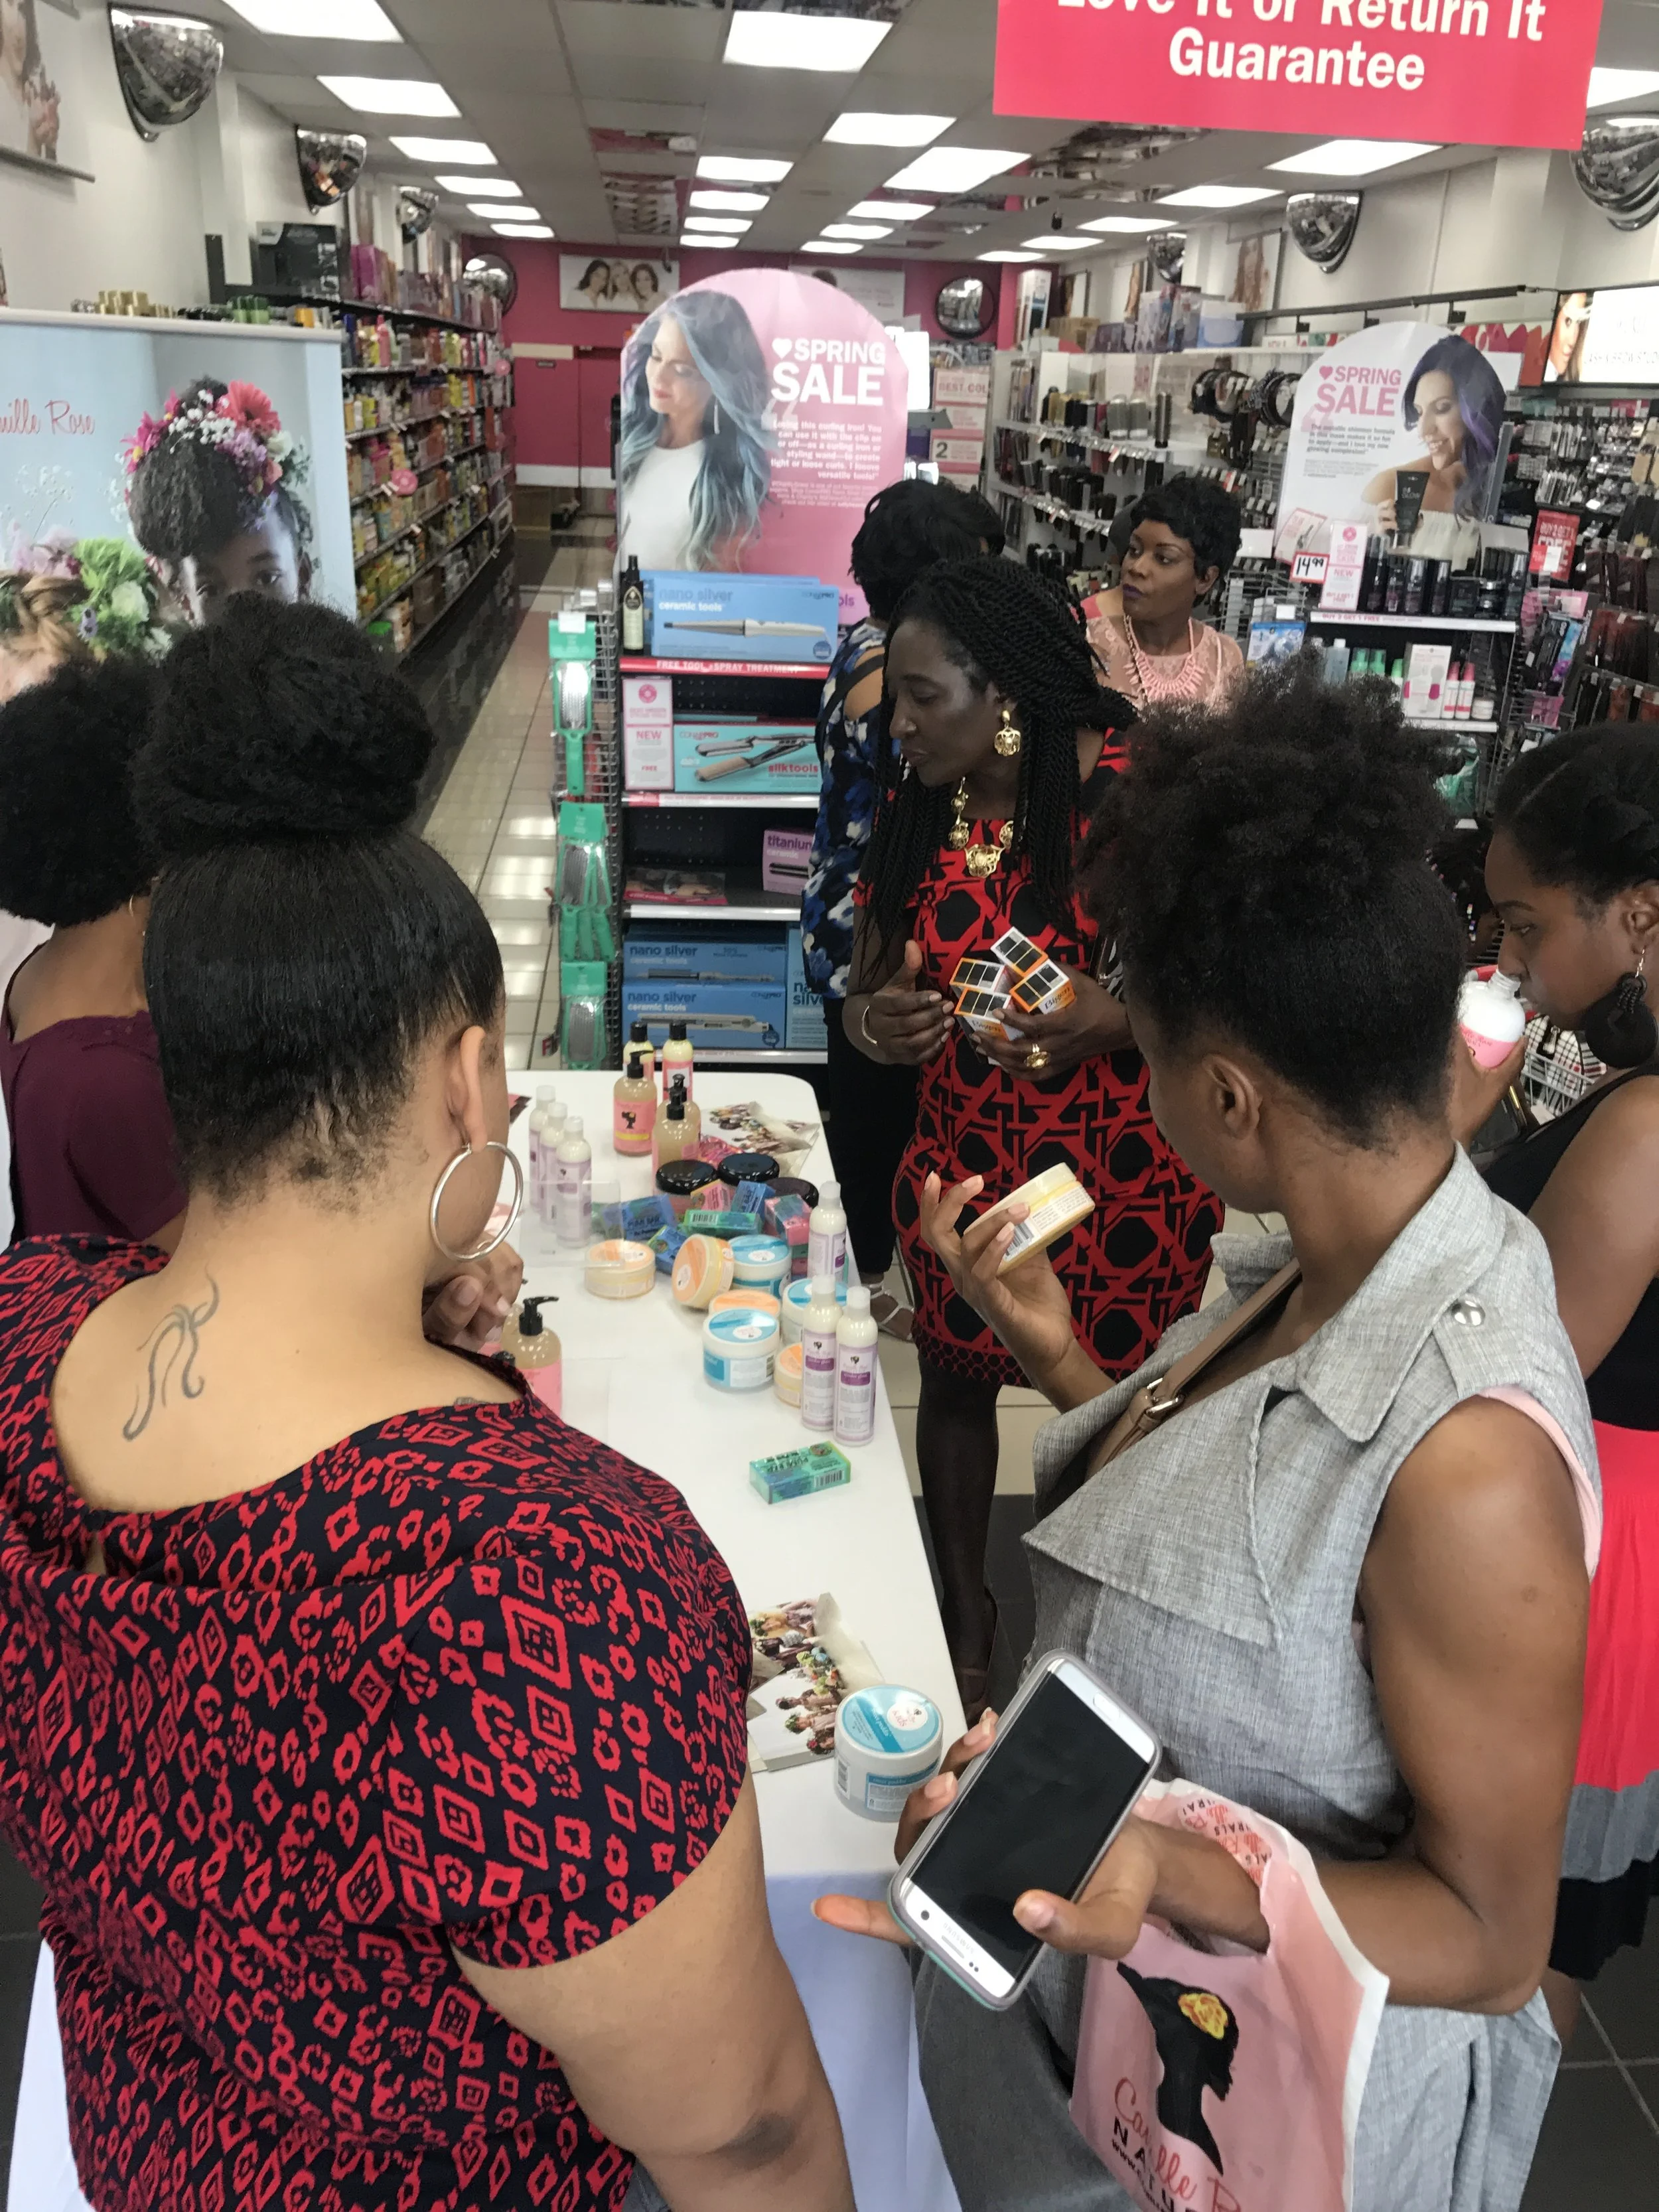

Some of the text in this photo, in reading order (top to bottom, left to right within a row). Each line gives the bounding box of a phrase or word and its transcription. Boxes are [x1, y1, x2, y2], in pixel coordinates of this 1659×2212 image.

[1507, 0, 1547, 41] It
[1169, 27, 1425, 90] Guarantee
[795, 338, 886, 364] SPRING
[771, 362, 884, 406] SALE
[1334, 365, 1402, 386] SPRING
[1314, 383, 1399, 417] SALE
[45, 400, 95, 435] Rose
[936, 441, 948, 459] 2
[1334, 569, 1354, 577] NEW
[659, 590, 693, 600] nano
[697, 589, 733, 602] silver
[658, 602, 723, 612] ceramic tools
[636, 731, 662, 740] NEW
[630, 946, 662, 956] nano
[665, 945, 698, 958] silver
[628, 992, 660, 1002] nano
[664, 991, 697, 1003] silver
[628, 1003, 687, 1012] ceramic tools
